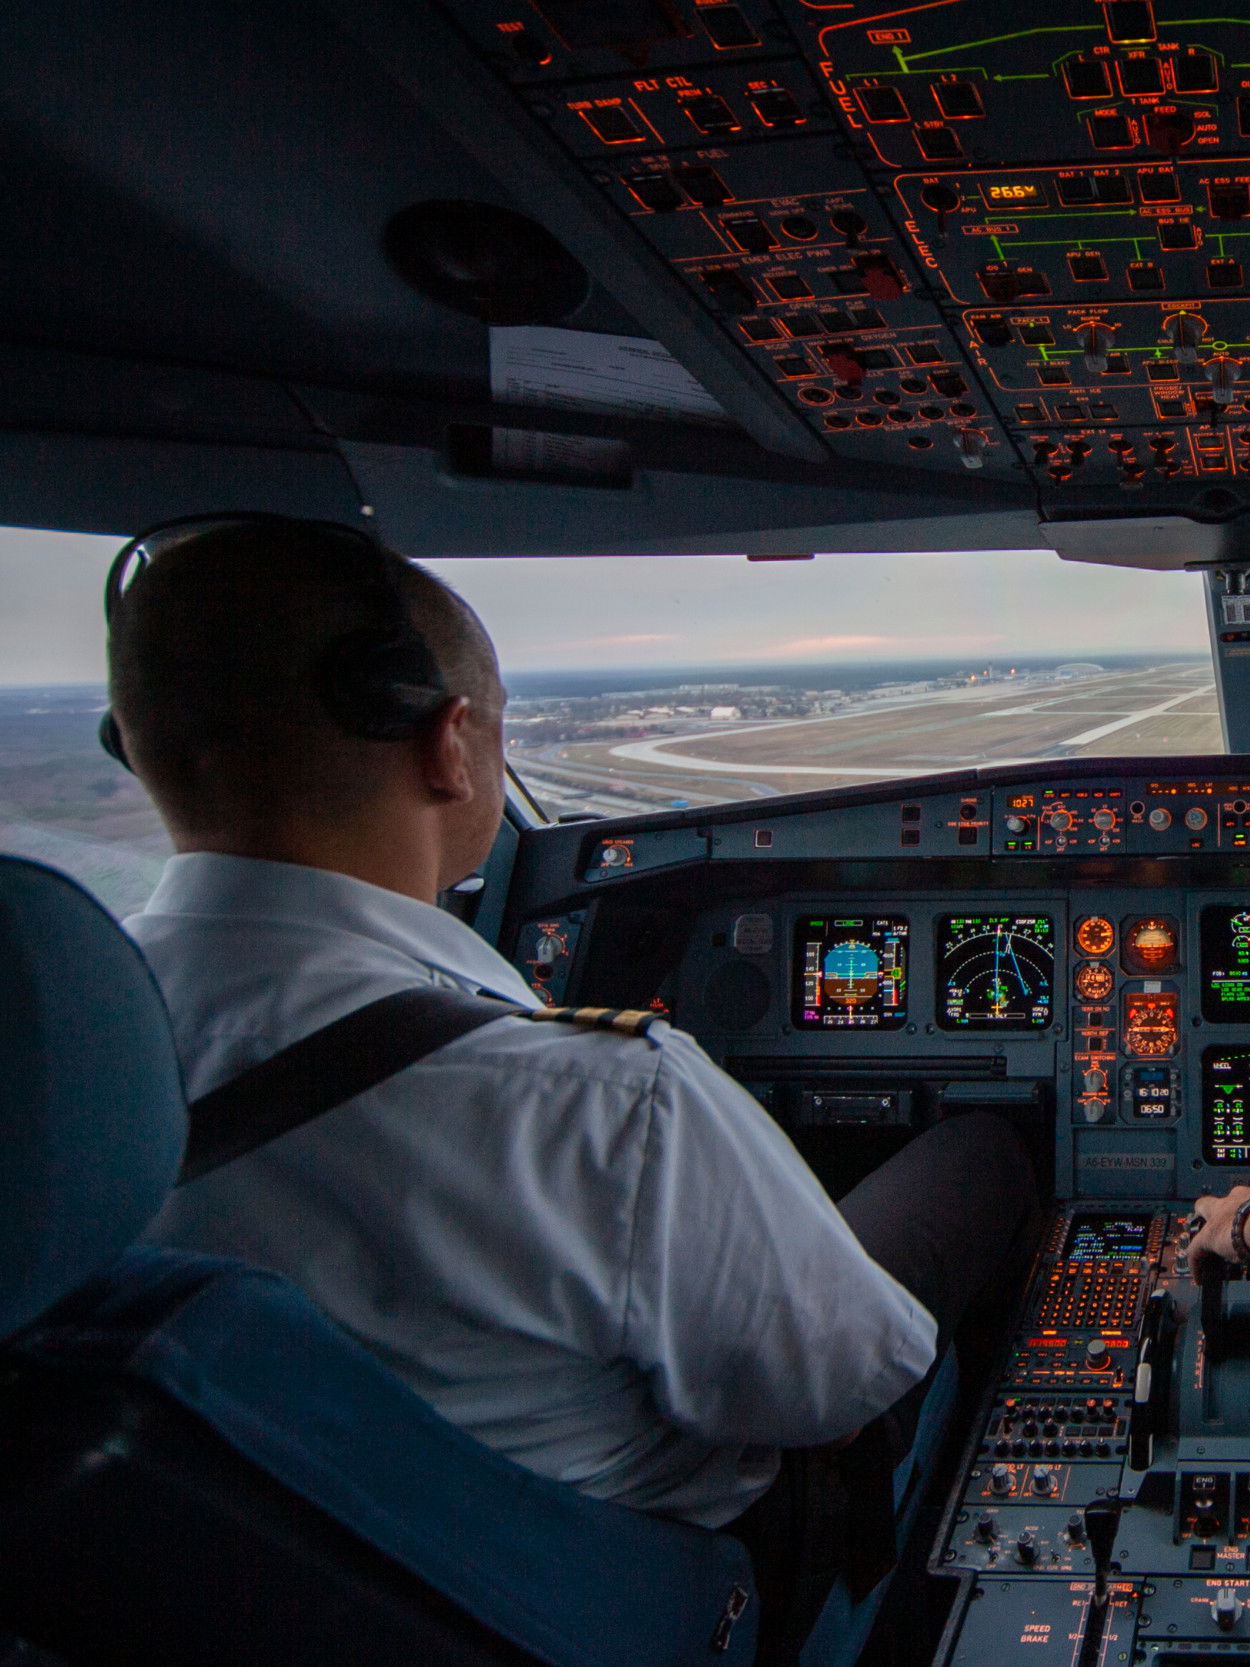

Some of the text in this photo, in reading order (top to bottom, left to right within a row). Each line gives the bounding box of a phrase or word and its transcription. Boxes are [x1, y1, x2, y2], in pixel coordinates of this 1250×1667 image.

[633, 77, 692, 92] FLT CTL
[819, 61, 863, 129] FUEL
[904, 220, 939, 269] ELEC
[1012, 799, 1034, 808] 1027
[1024, 1625, 1051, 1633] SPEED
[1020, 1635, 1049, 1643] BRAKE
